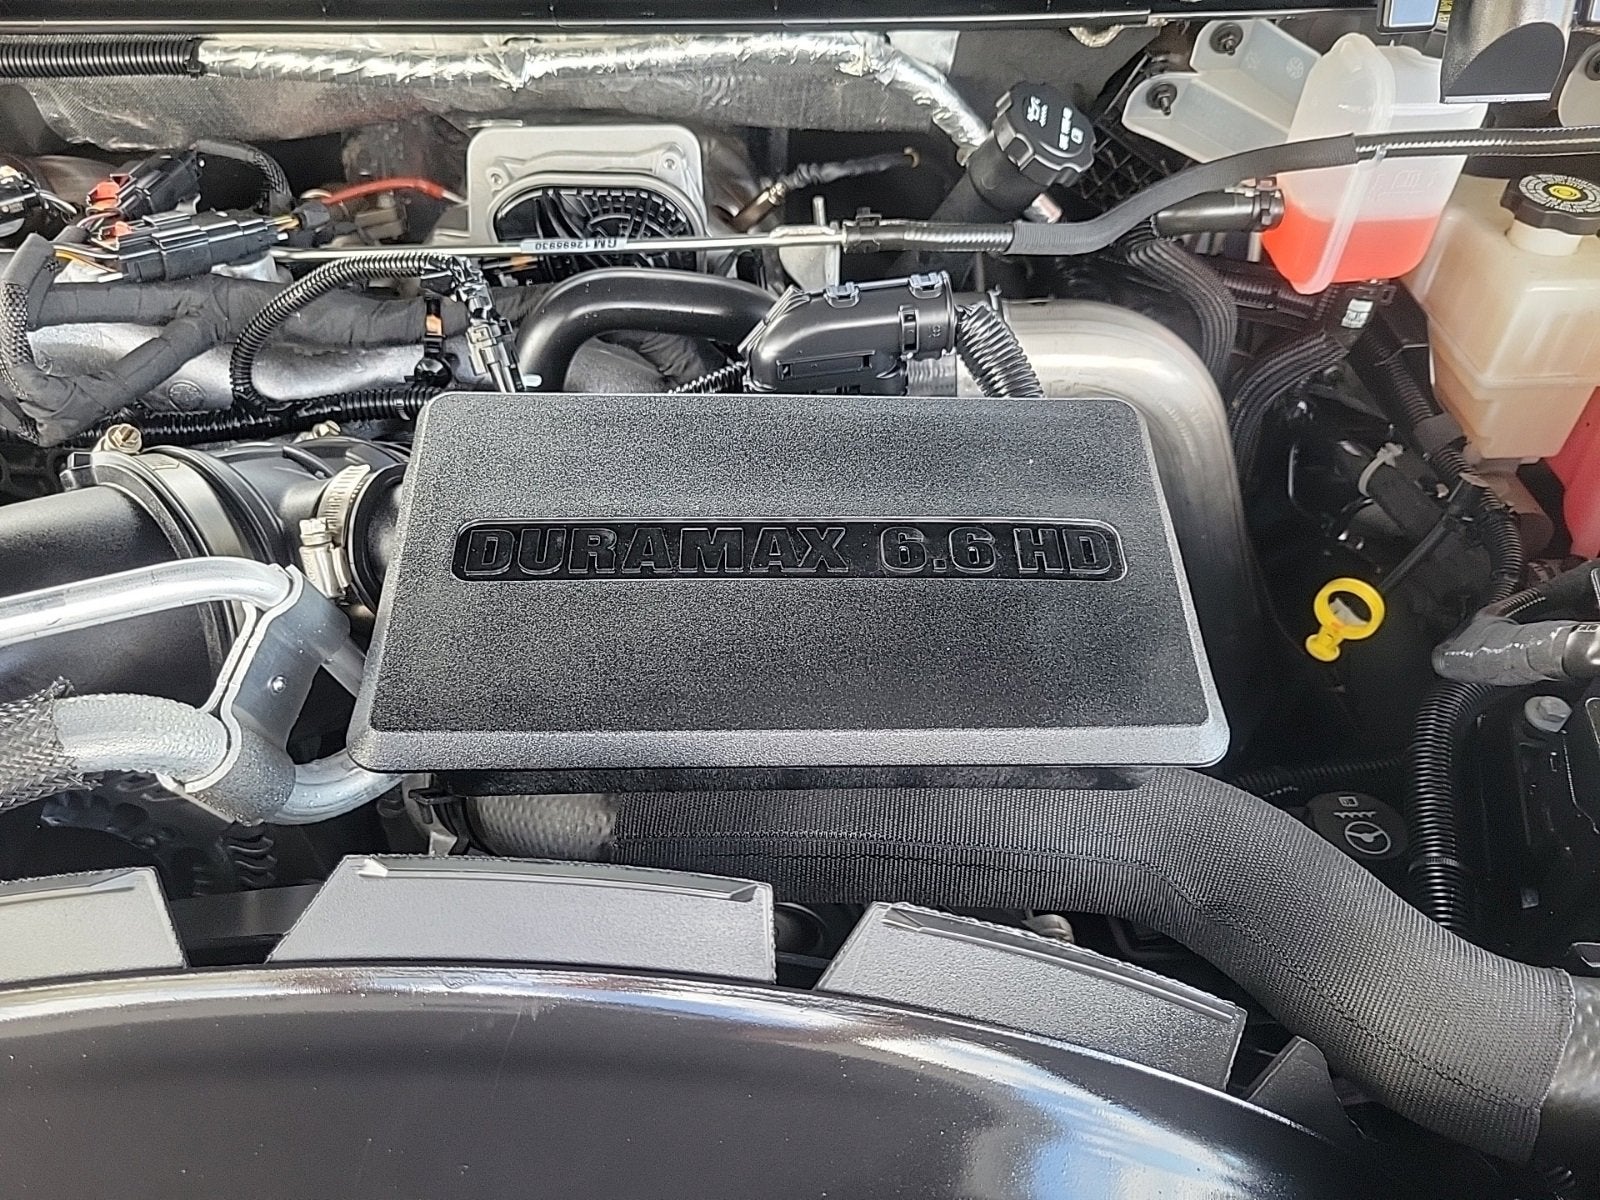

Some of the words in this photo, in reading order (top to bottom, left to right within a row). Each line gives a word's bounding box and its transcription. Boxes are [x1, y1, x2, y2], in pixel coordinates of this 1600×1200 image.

[593, 238, 618, 248] GM
[464, 528, 849, 575] DURAMAX
[880, 527, 998, 573] 6.6
[1013, 528, 1112, 575] HD
